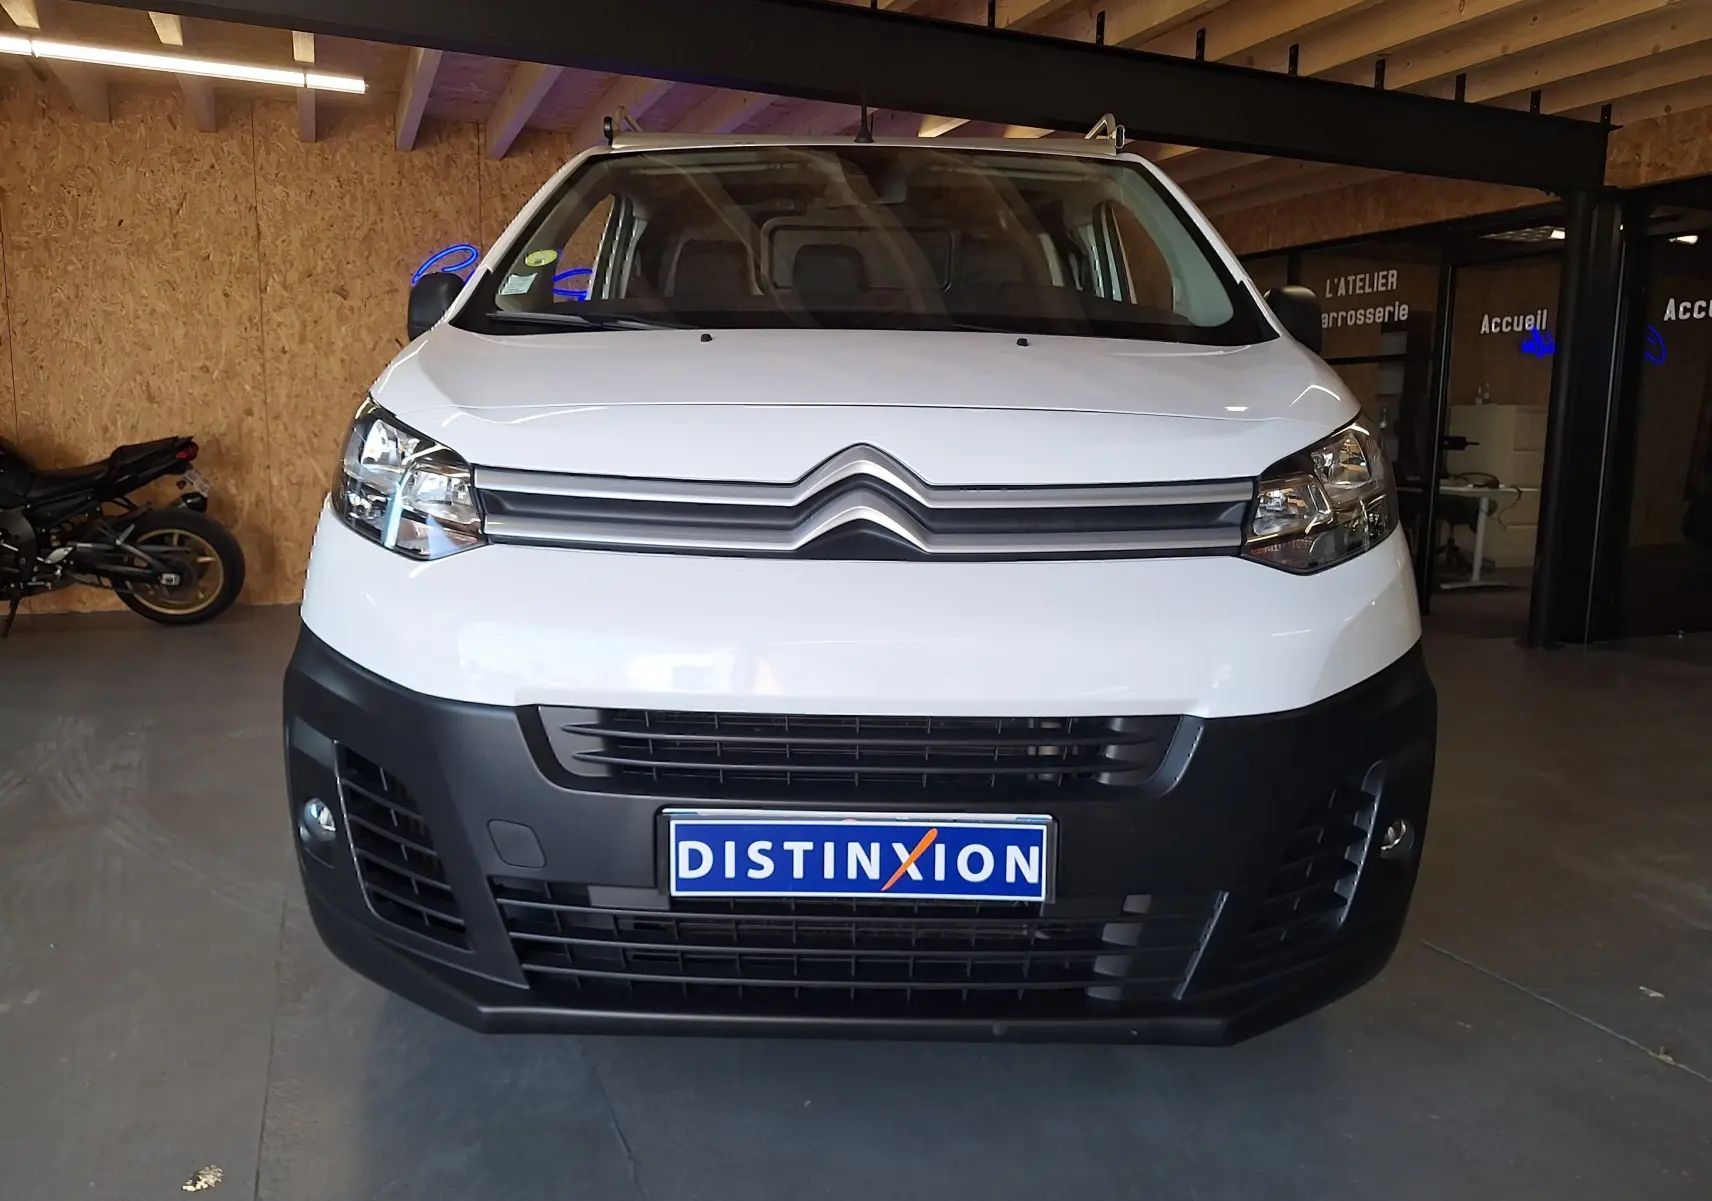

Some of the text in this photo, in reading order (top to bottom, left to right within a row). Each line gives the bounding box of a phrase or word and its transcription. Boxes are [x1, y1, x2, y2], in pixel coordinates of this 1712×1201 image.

[1325, 269, 1398, 298] L'ATELIER
[1321, 301, 1409, 329] arrosserie
[1480, 309, 1548, 334] Accueil
[677, 828, 1040, 891] DISTINXION
